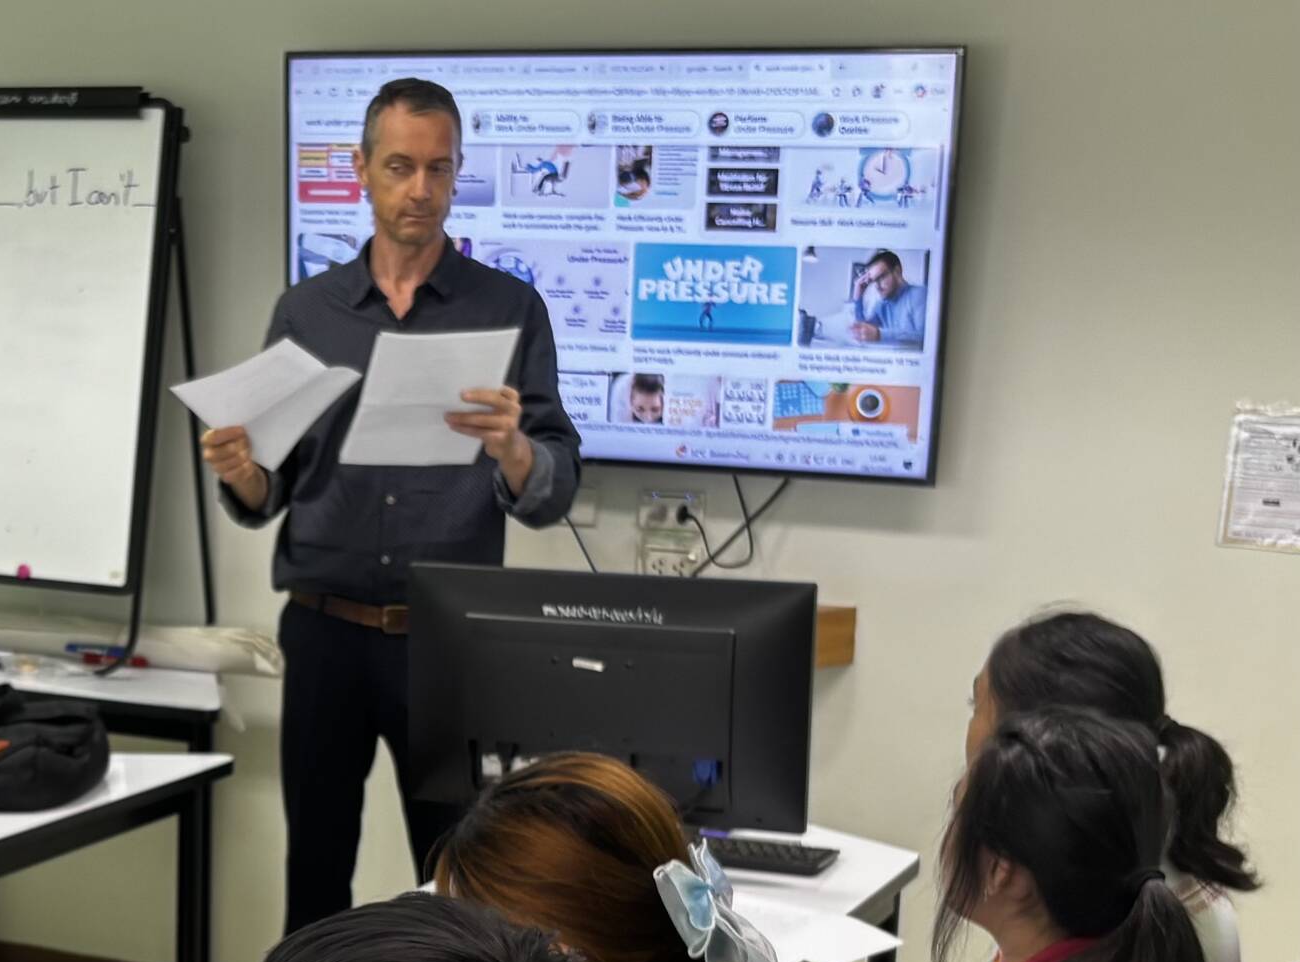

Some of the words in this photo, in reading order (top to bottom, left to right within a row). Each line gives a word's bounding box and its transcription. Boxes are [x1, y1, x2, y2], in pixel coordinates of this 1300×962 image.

[25, 169, 60, 207] but
[66, 167, 89, 206] I
[662, 255, 764, 282] UNDER
[638, 278, 788, 305] PRESSURE
